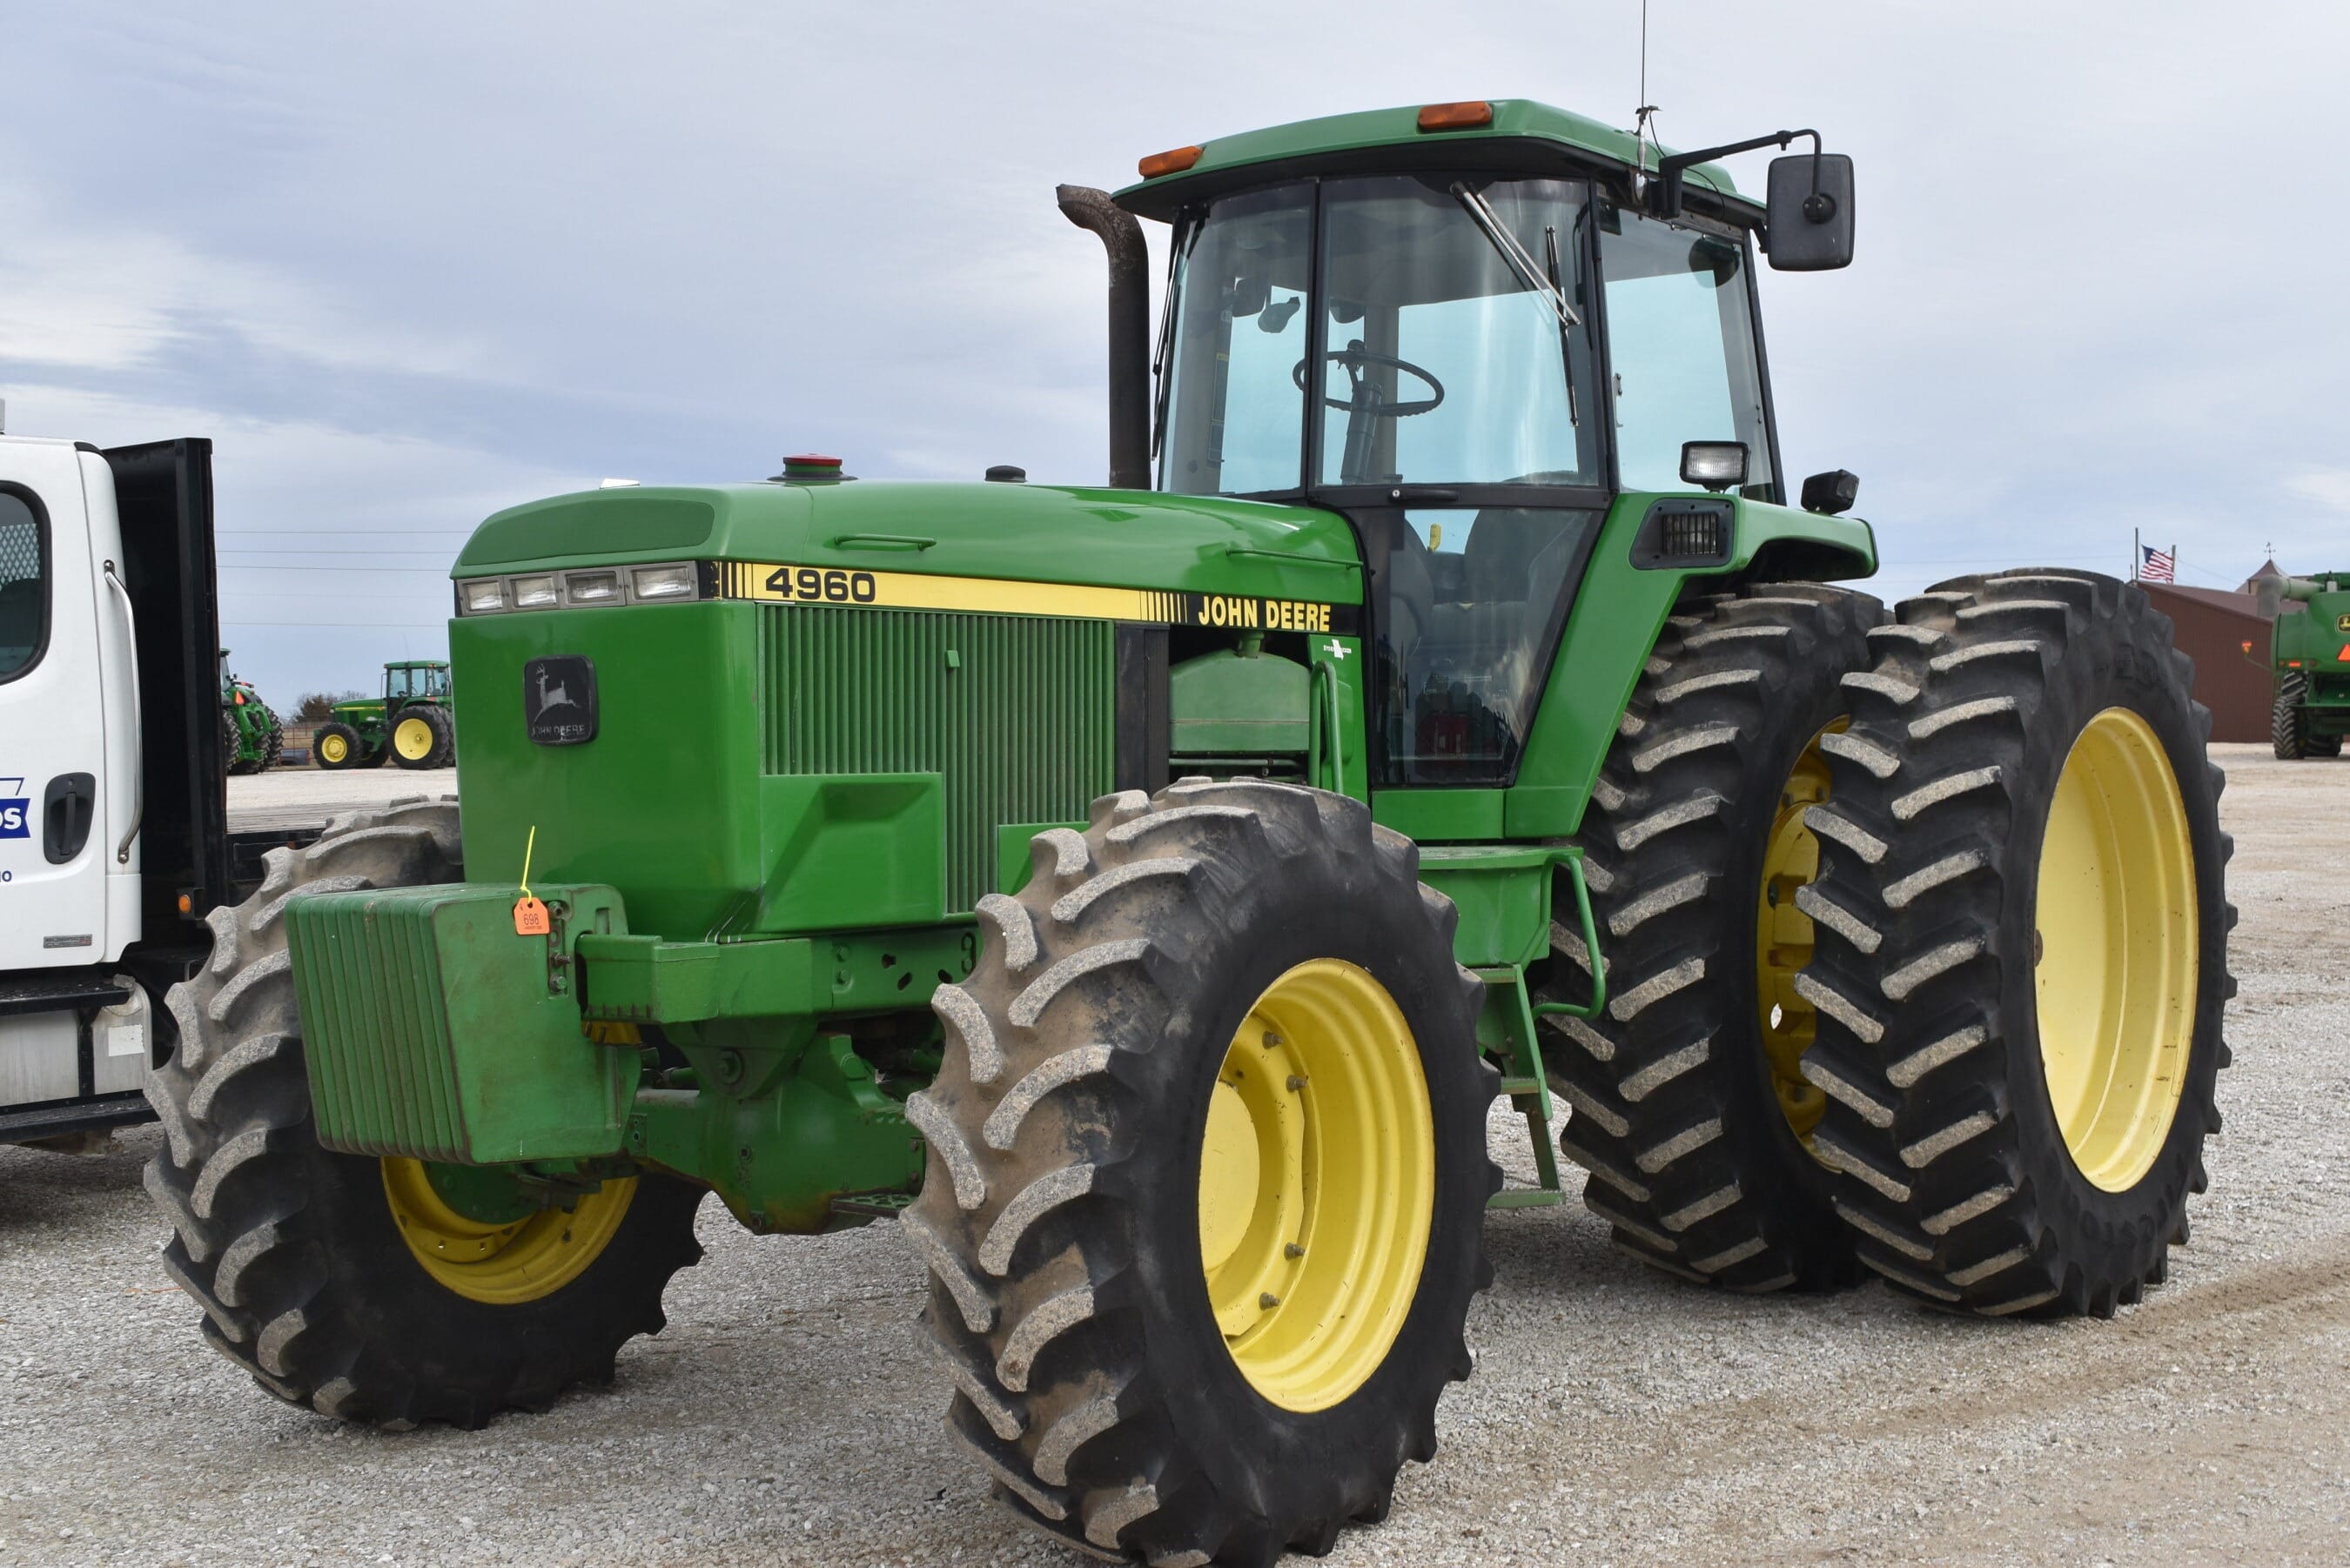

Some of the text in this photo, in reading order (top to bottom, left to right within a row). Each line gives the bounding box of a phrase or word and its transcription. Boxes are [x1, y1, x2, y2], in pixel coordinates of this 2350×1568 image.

[766, 567, 876, 602] 4960
[1198, 595, 1331, 632] JOHN DEERE
[0, 807, 23, 830] S
[523, 913, 540, 925] 698
